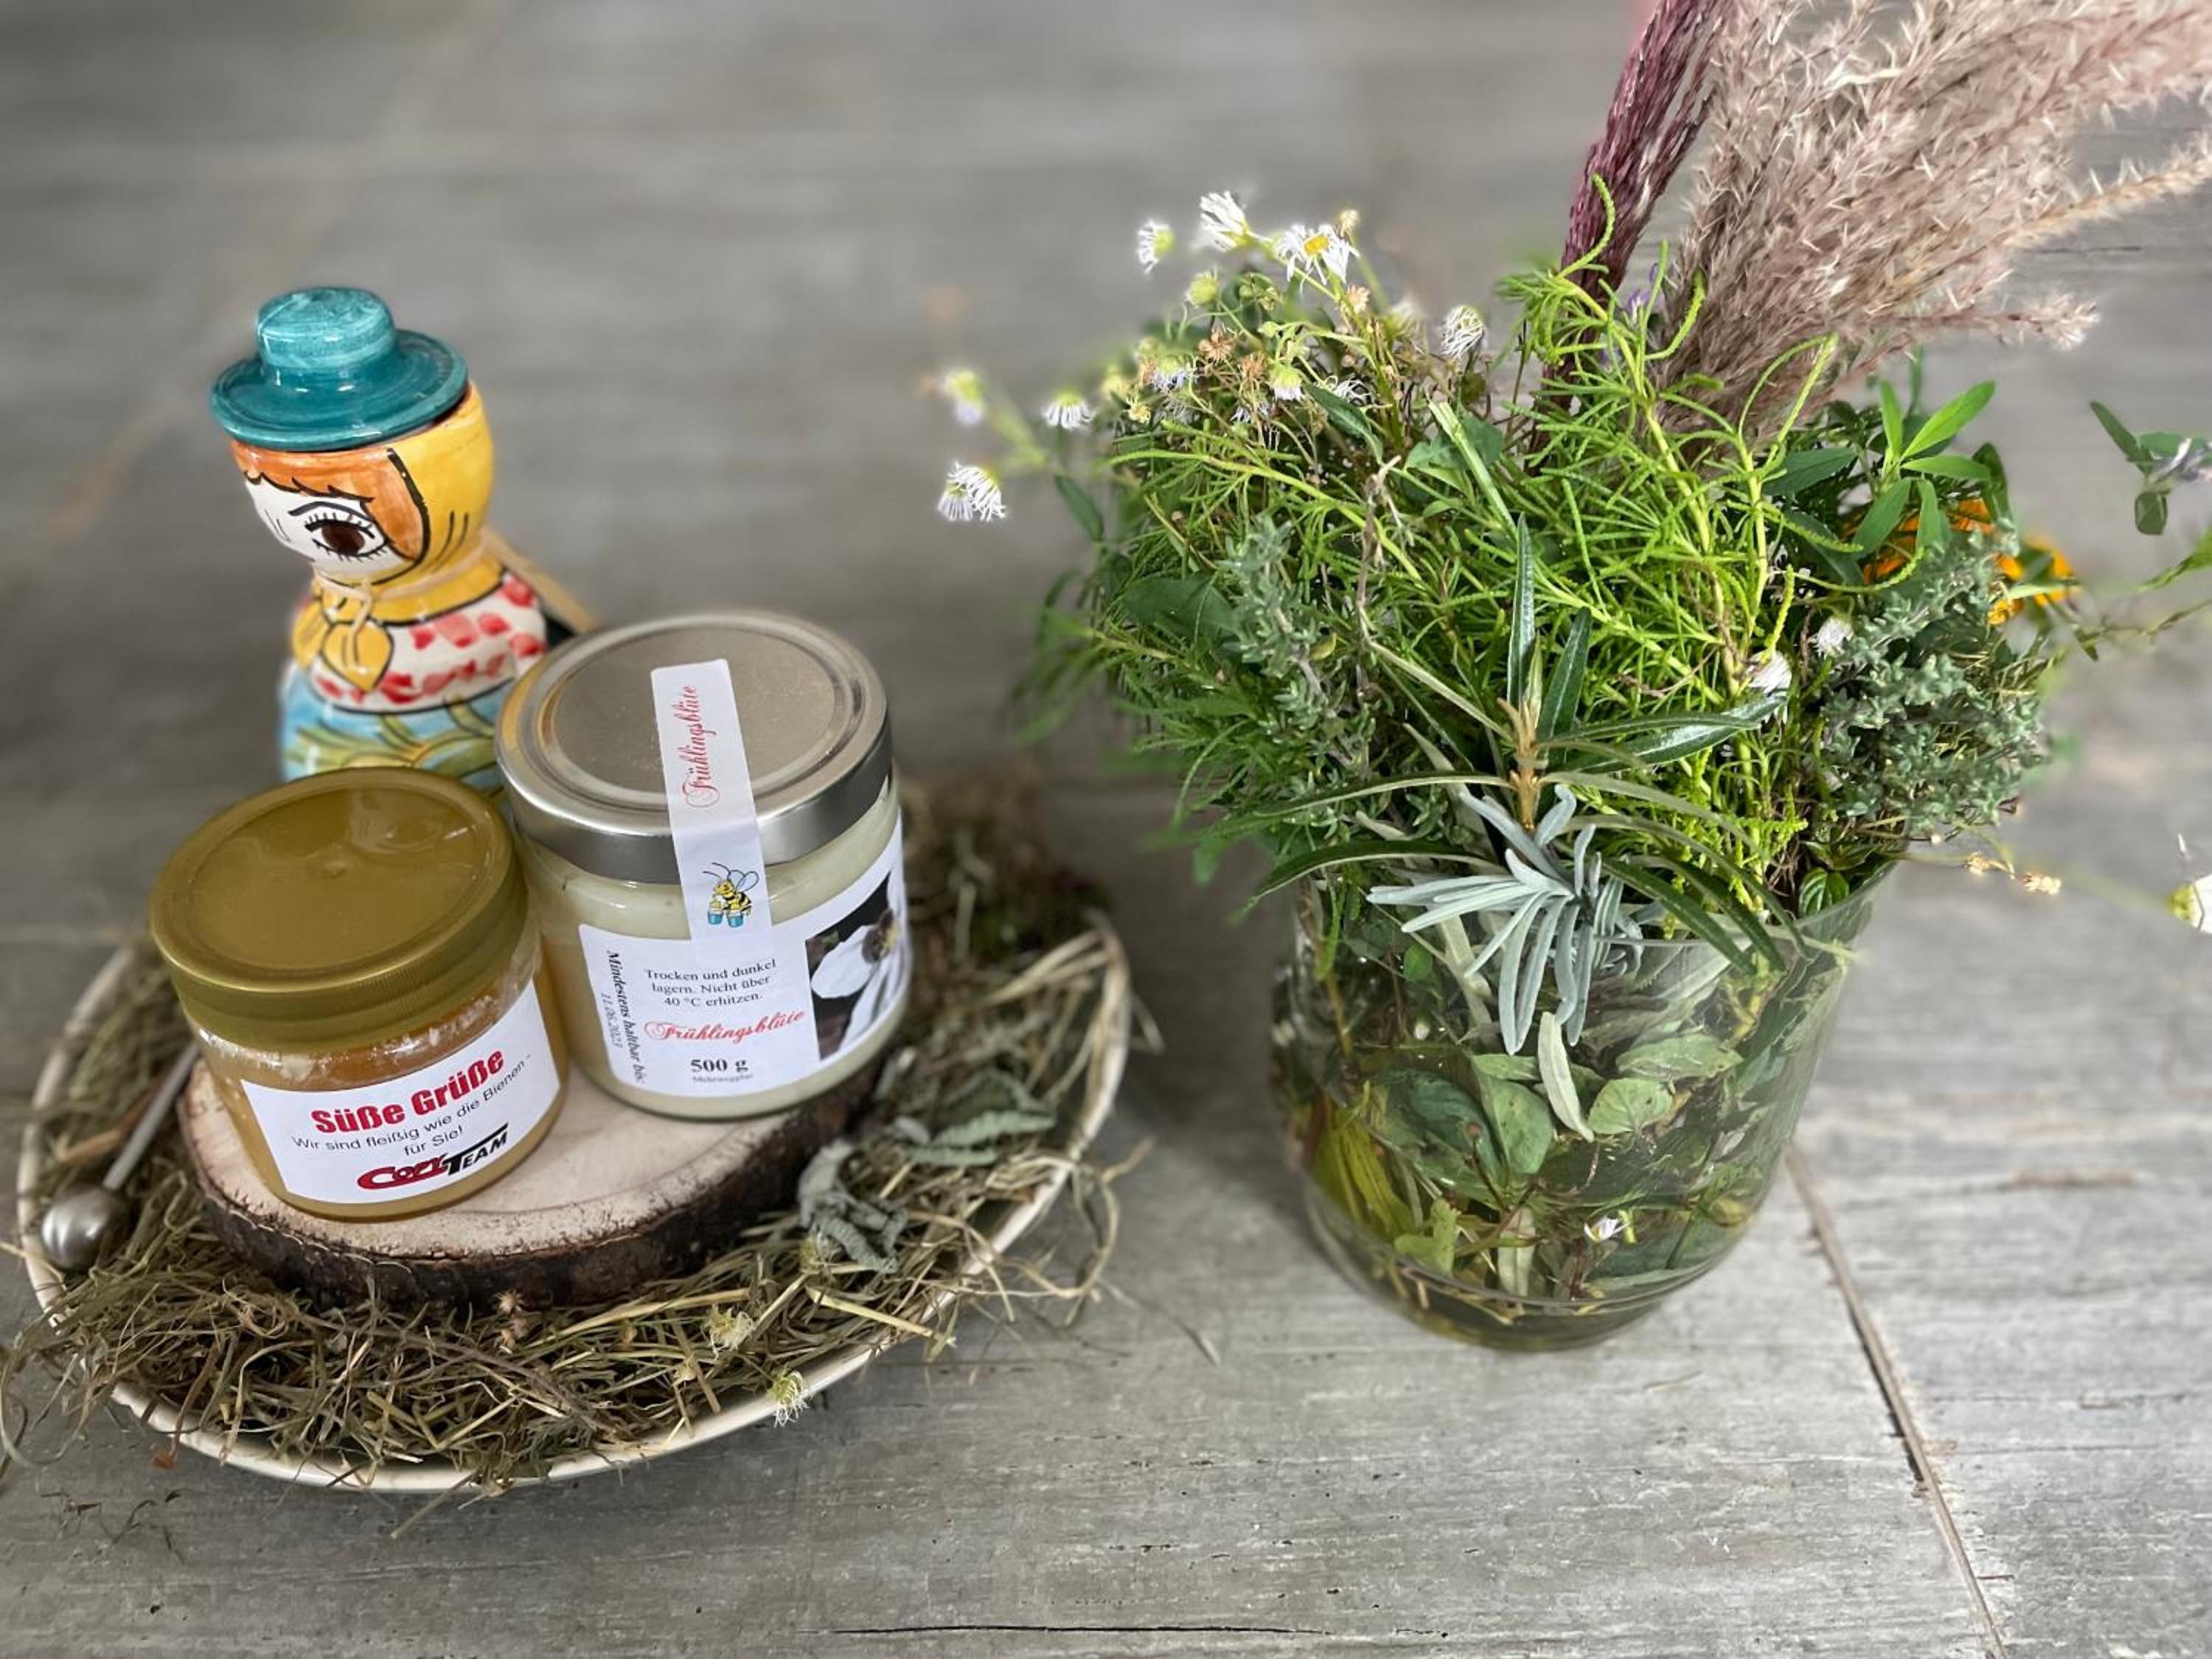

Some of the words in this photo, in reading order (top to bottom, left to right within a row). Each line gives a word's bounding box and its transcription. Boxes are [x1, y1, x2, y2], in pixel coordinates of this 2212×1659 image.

[647, 969, 698, 981] Trocken
[703, 969, 728, 980] und
[732, 959, 776, 978] dunkel
[652, 982, 695, 995] lagern.
[700, 981, 738, 994] Nicht
[742, 975, 770, 989] über
[606, 950, 630, 1018] Mindestens
[623, 1020, 641, 1062] haltbar
[664, 997, 680, 1006] 40
[684, 997, 700, 1006] °C
[706, 992, 763, 1006] erhitzen.
[644, 1010, 805, 1044] Frühlingsblüte
[690, 1059, 728, 1073] 500
[735, 1060, 748, 1072] g
[292, 1135, 319, 1150] Wir
[326, 1138, 361, 1150] sind
[366, 1128, 420, 1147] fleißig
[424, 1113, 452, 1133] wie
[457, 1100, 480, 1118] die
[483, 1060, 525, 1101] Bienen
[311, 1105, 405, 1133] Süße
[411, 1051, 504, 1116] Grüße
[404, 1141, 427, 1156] für
[432, 1125, 463, 1147] Sie!
